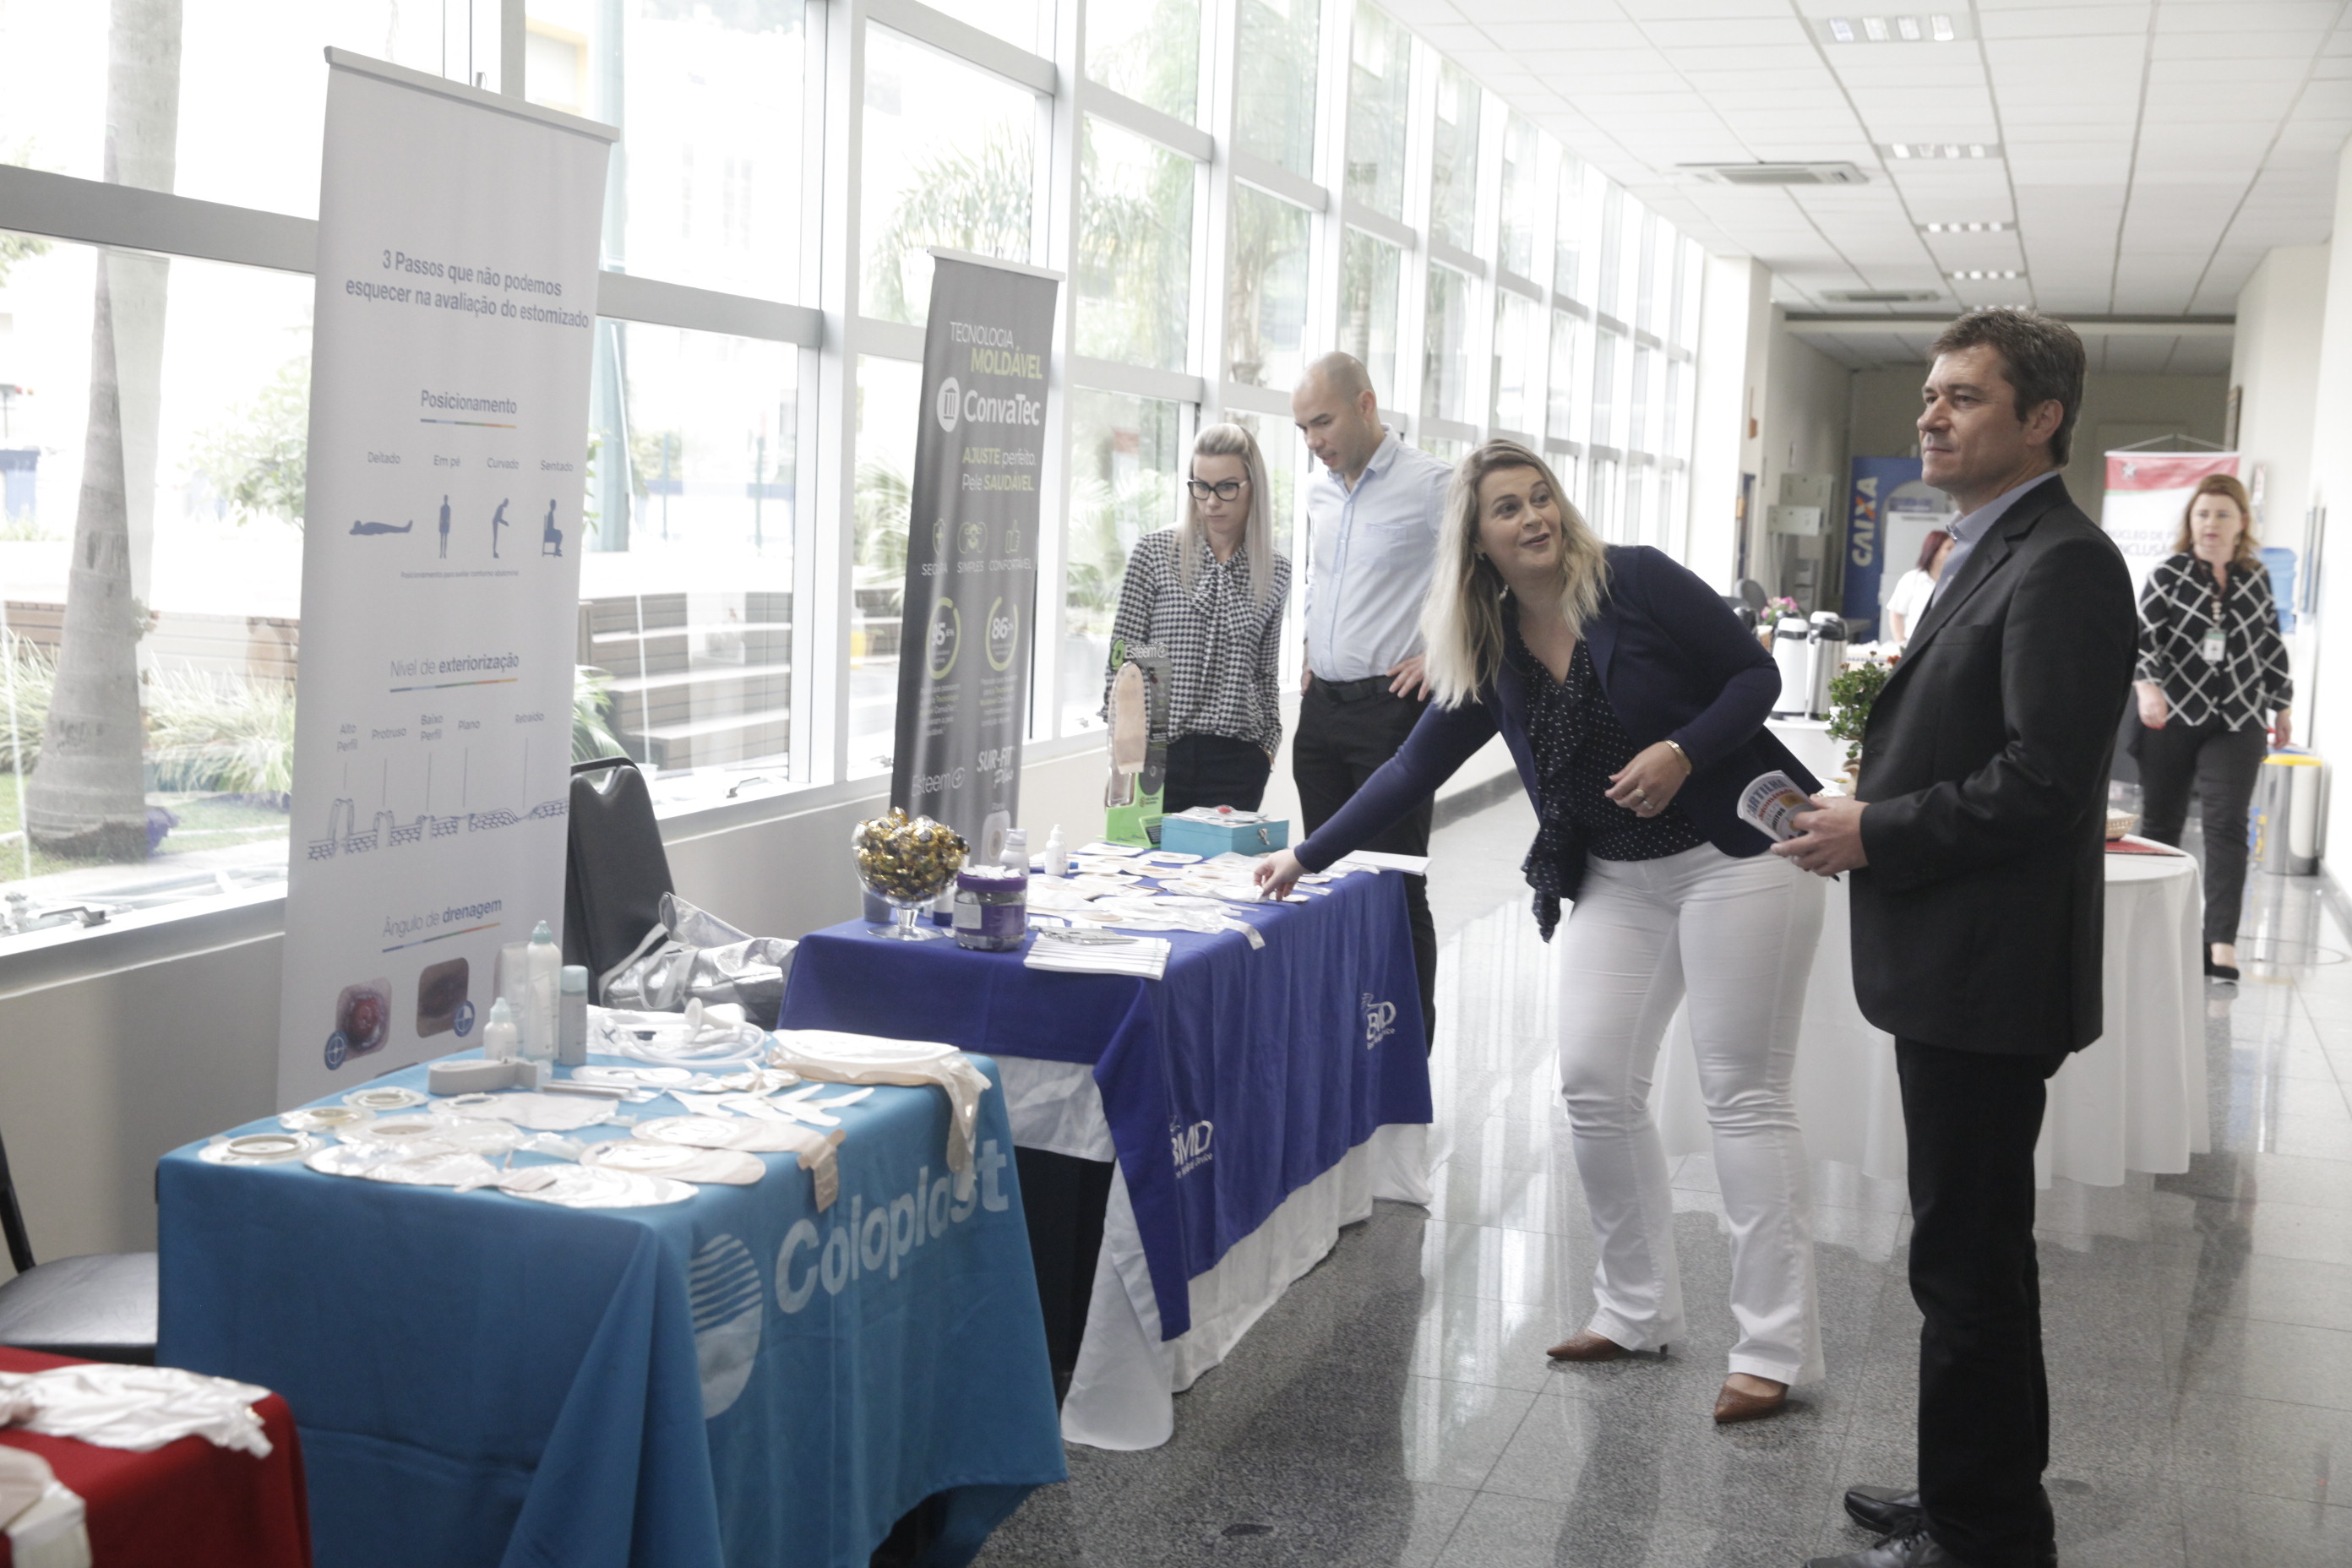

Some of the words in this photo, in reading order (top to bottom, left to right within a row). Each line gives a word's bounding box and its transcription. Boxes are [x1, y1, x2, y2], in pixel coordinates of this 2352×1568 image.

[383, 249, 392, 269] 3
[395, 251, 444, 278] Passos
[448, 264, 474, 285] que
[476, 265, 501, 287] não
[504, 274, 563, 297] podemos
[346, 279, 412, 303] esquecer
[415, 289, 432, 307] na
[435, 291, 497, 318] avaliação
[500, 298, 517, 319] do
[520, 306, 589, 329] estomizado
[950, 321, 1014, 348] TECNOLOGIA
[971, 346, 1043, 379] MOLDÁVEL
[421, 389, 517, 415] Posicionamento
[964, 389, 1041, 426] ConvaTec
[368, 451, 400, 465] Deitado
[433, 455, 448, 466] Em
[449, 455, 461, 469] pé
[487, 457, 520, 470] Curvado
[962, 447, 1001, 465] AJUSTE
[541, 460, 574, 472] Sentado
[962, 473, 983, 491] Pele
[1852, 476, 1879, 567] CAIXA
[420, 659, 436, 675] de
[438, 651, 520, 674] exteriorização
[421, 713, 444, 726] Baixo
[458, 719, 481, 731] Plano
[340, 723, 357, 736] Alto
[371, 727, 406, 741] Protruso
[420, 729, 443, 742] Perfil
[337, 738, 358, 753] Perfil
[383, 915, 423, 939] Ângulo
[426, 908, 439, 928] de
[443, 899, 502, 924] drenagem
